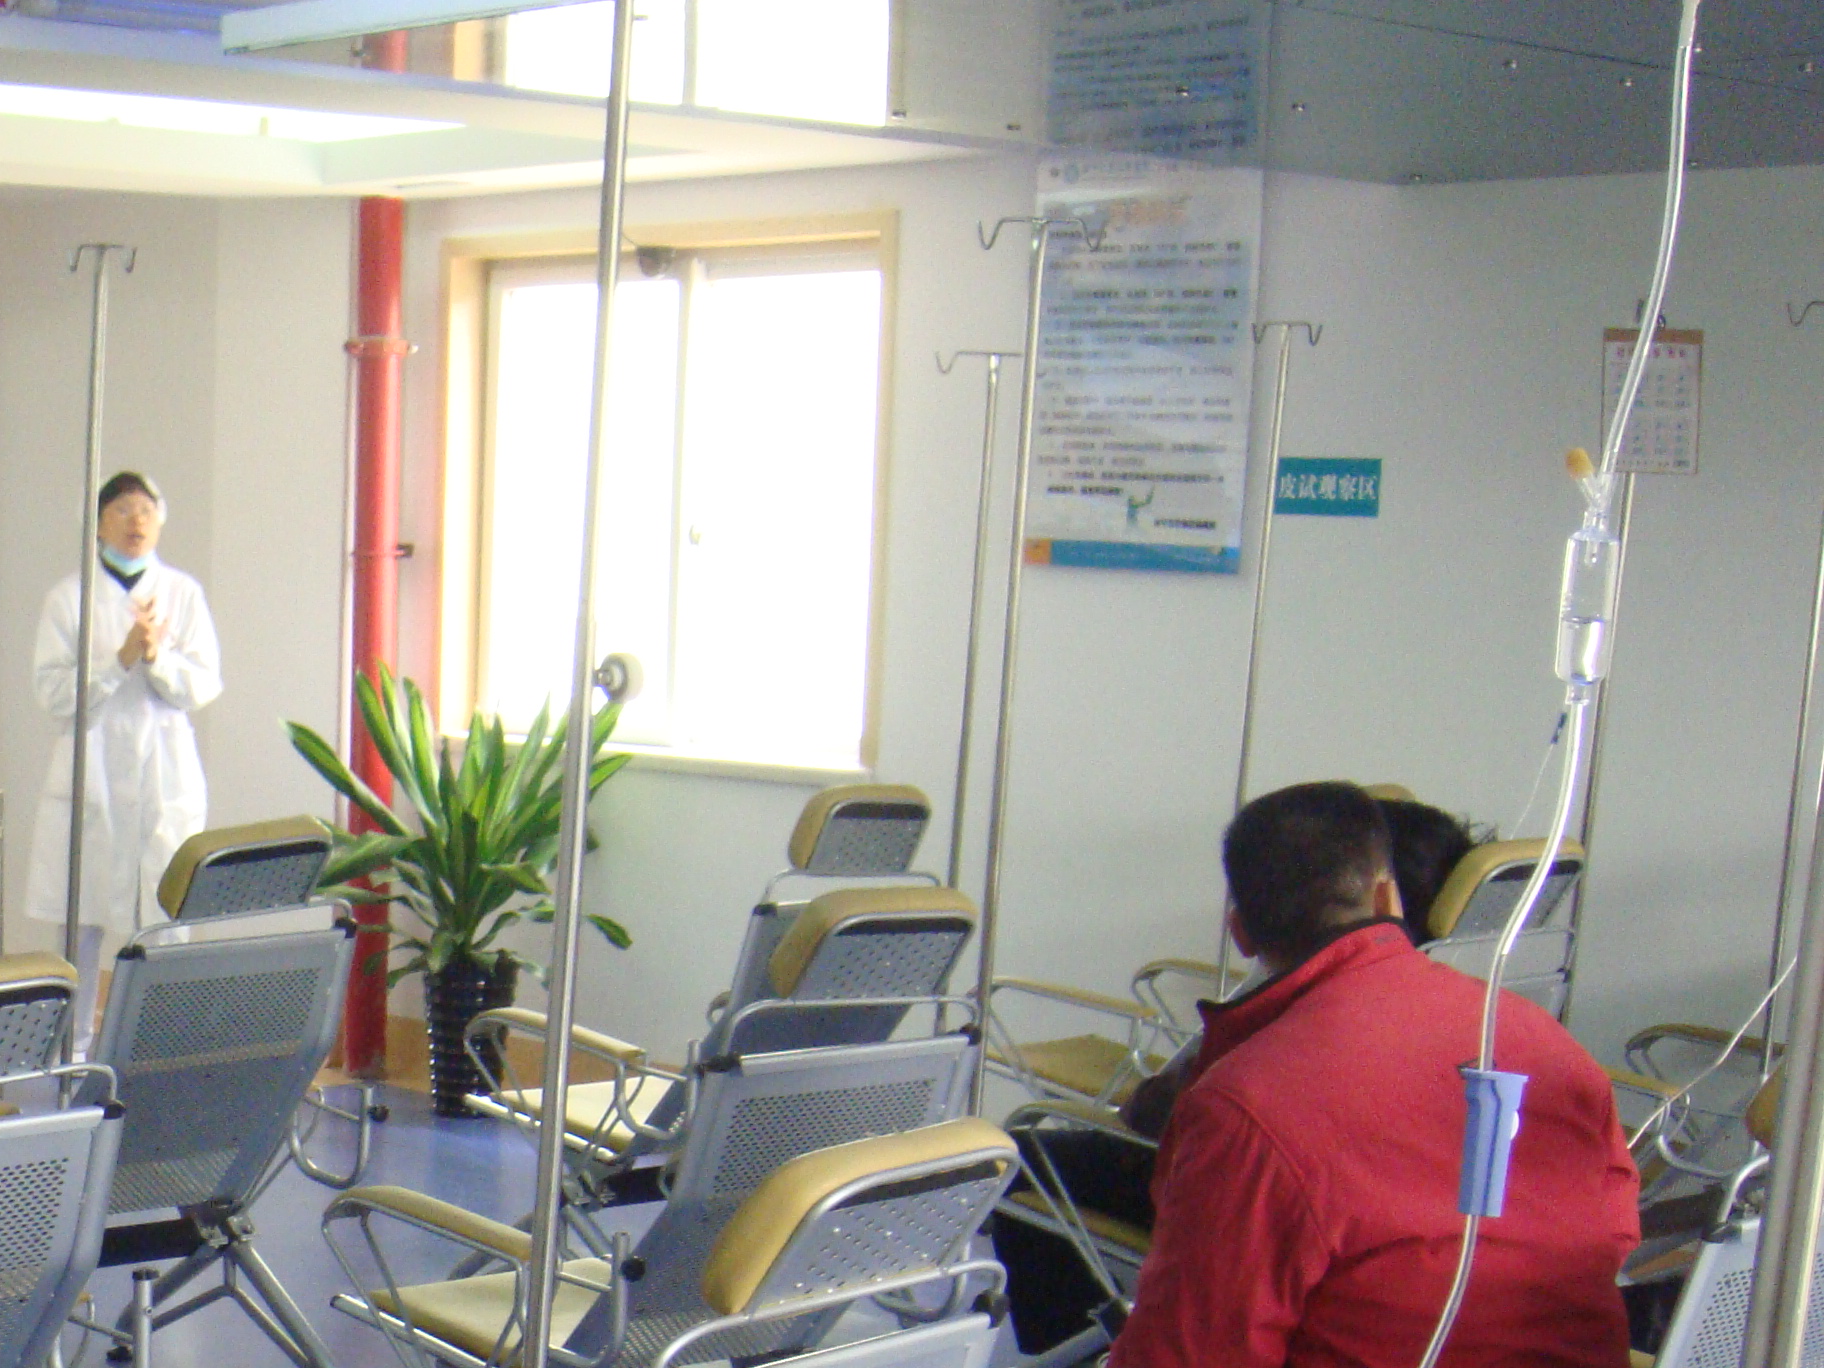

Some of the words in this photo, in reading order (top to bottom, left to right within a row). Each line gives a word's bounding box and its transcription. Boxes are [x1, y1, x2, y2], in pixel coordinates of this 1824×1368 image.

[1278, 472, 1377, 501] 皮试观察区
